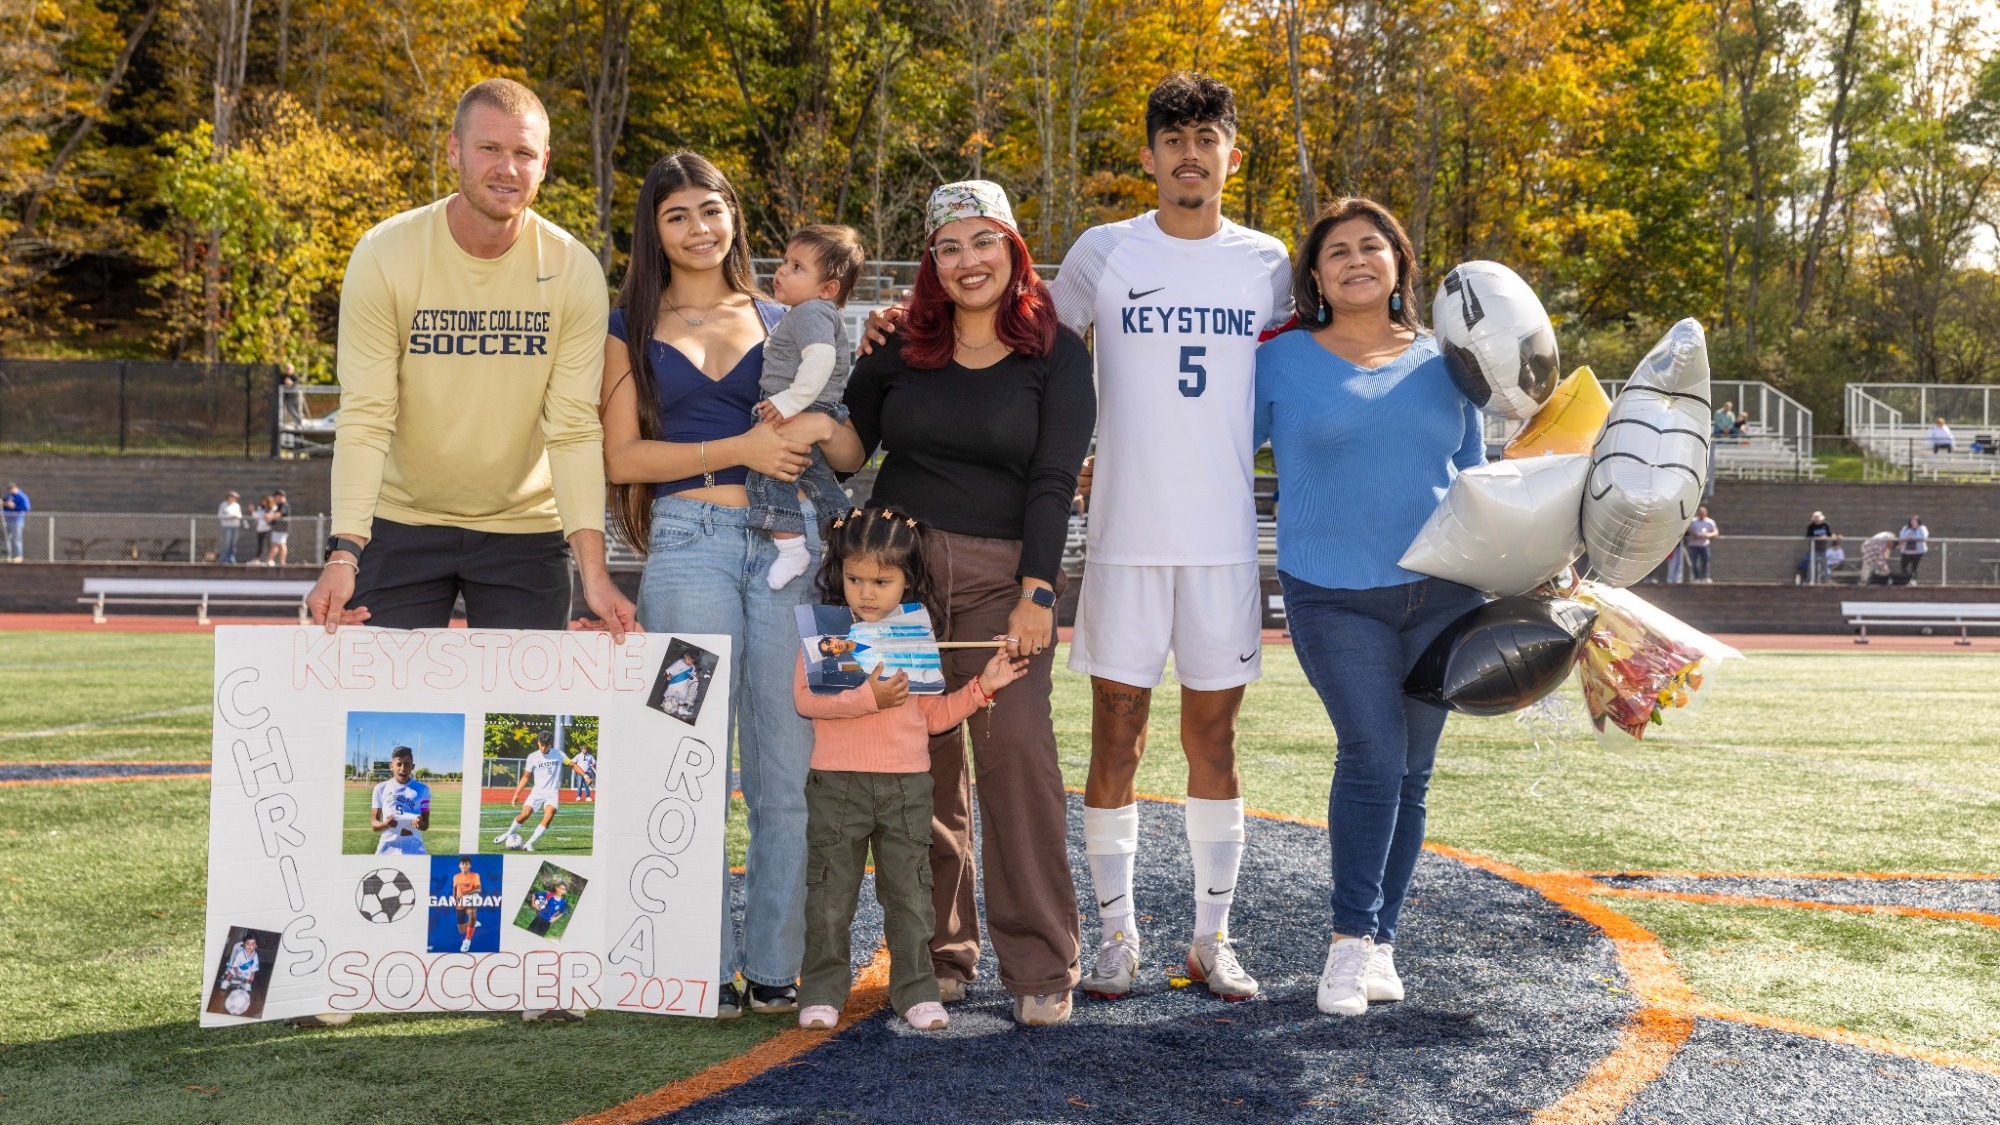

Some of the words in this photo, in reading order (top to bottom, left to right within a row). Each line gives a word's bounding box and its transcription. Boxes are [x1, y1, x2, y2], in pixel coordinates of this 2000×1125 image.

[411, 309, 487, 332] KEYSTONE
[489, 310, 550, 332] COLLEGE
[1122, 306, 1256, 336] KEYSTONE
[409, 333, 548, 356] SOCCER
[1178, 346, 1207, 398] 5
[292, 629, 647, 693] KEYSTONE
[217, 666, 328, 978] CHRIS
[607, 735, 716, 978] ROCA
[428, 895, 503, 908] GAMEDAY
[327, 950, 603, 1012] SOCCER
[616, 971, 708, 1014] 2027
